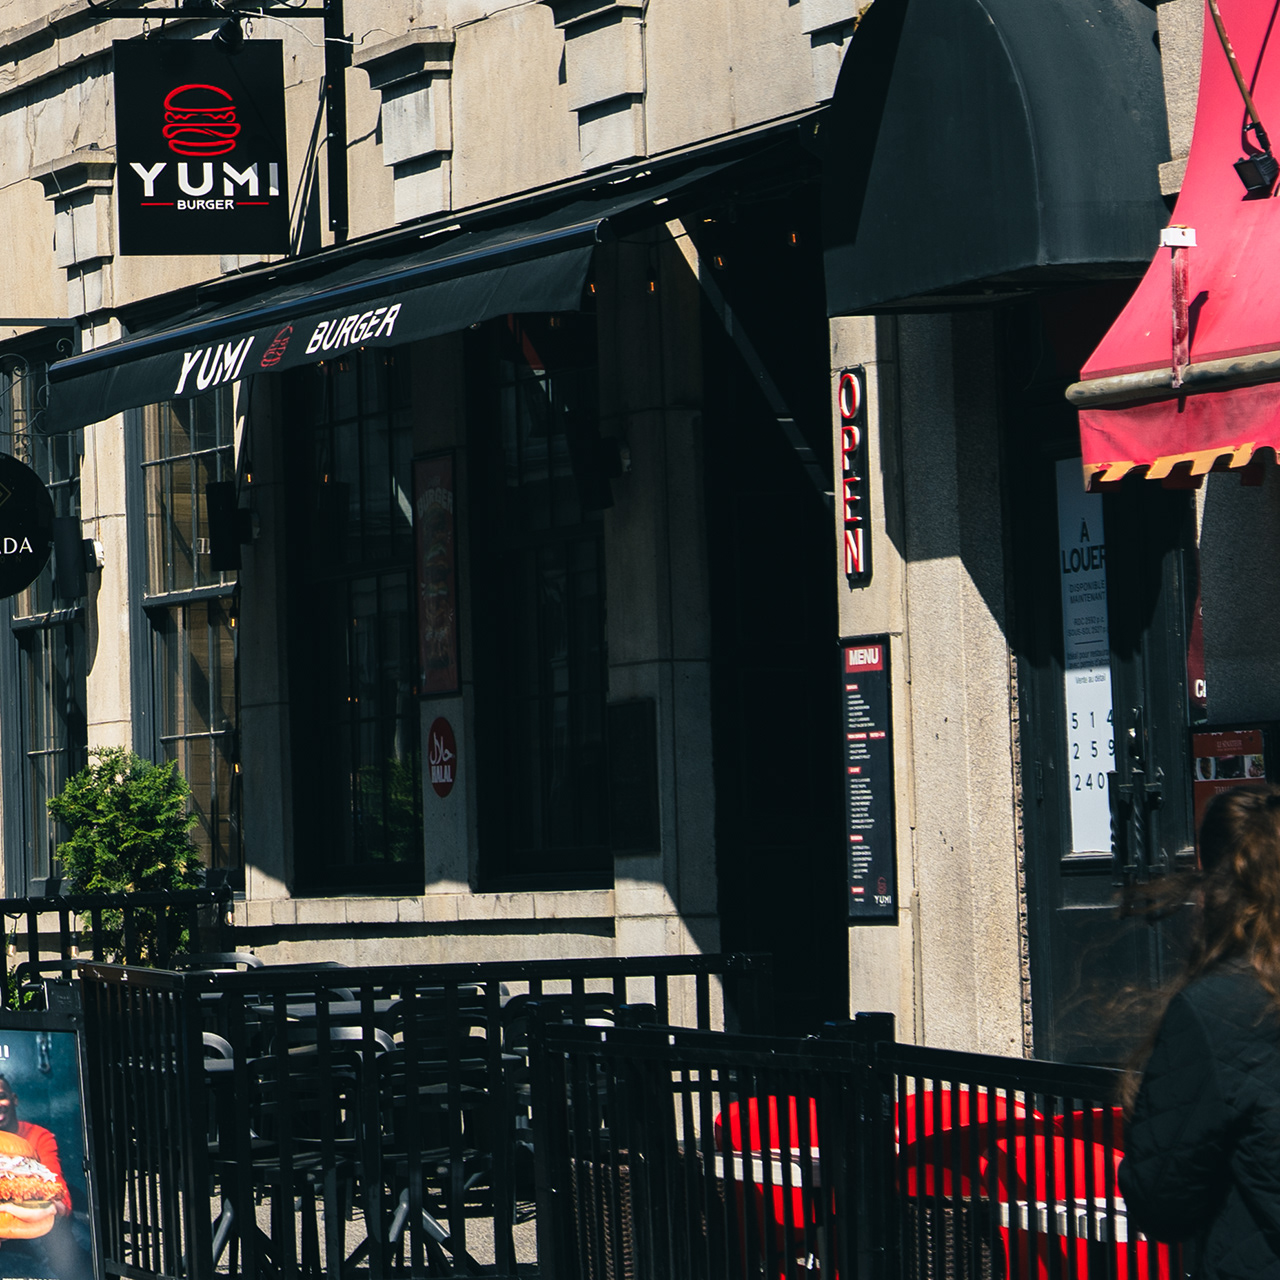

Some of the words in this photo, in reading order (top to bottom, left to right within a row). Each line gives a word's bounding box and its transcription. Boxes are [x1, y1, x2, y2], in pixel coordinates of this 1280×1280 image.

[129, 161, 280, 197] YUMI
[176, 199, 235, 210] BURGER
[174, 335, 256, 395] YUMI
[304, 302, 403, 355] BURGER
[838, 373, 864, 574] OPEN
[1080, 517, 1090, 543] À
[849, 647, 879, 666] MENU
[873, 895, 892, 904] YUMI
